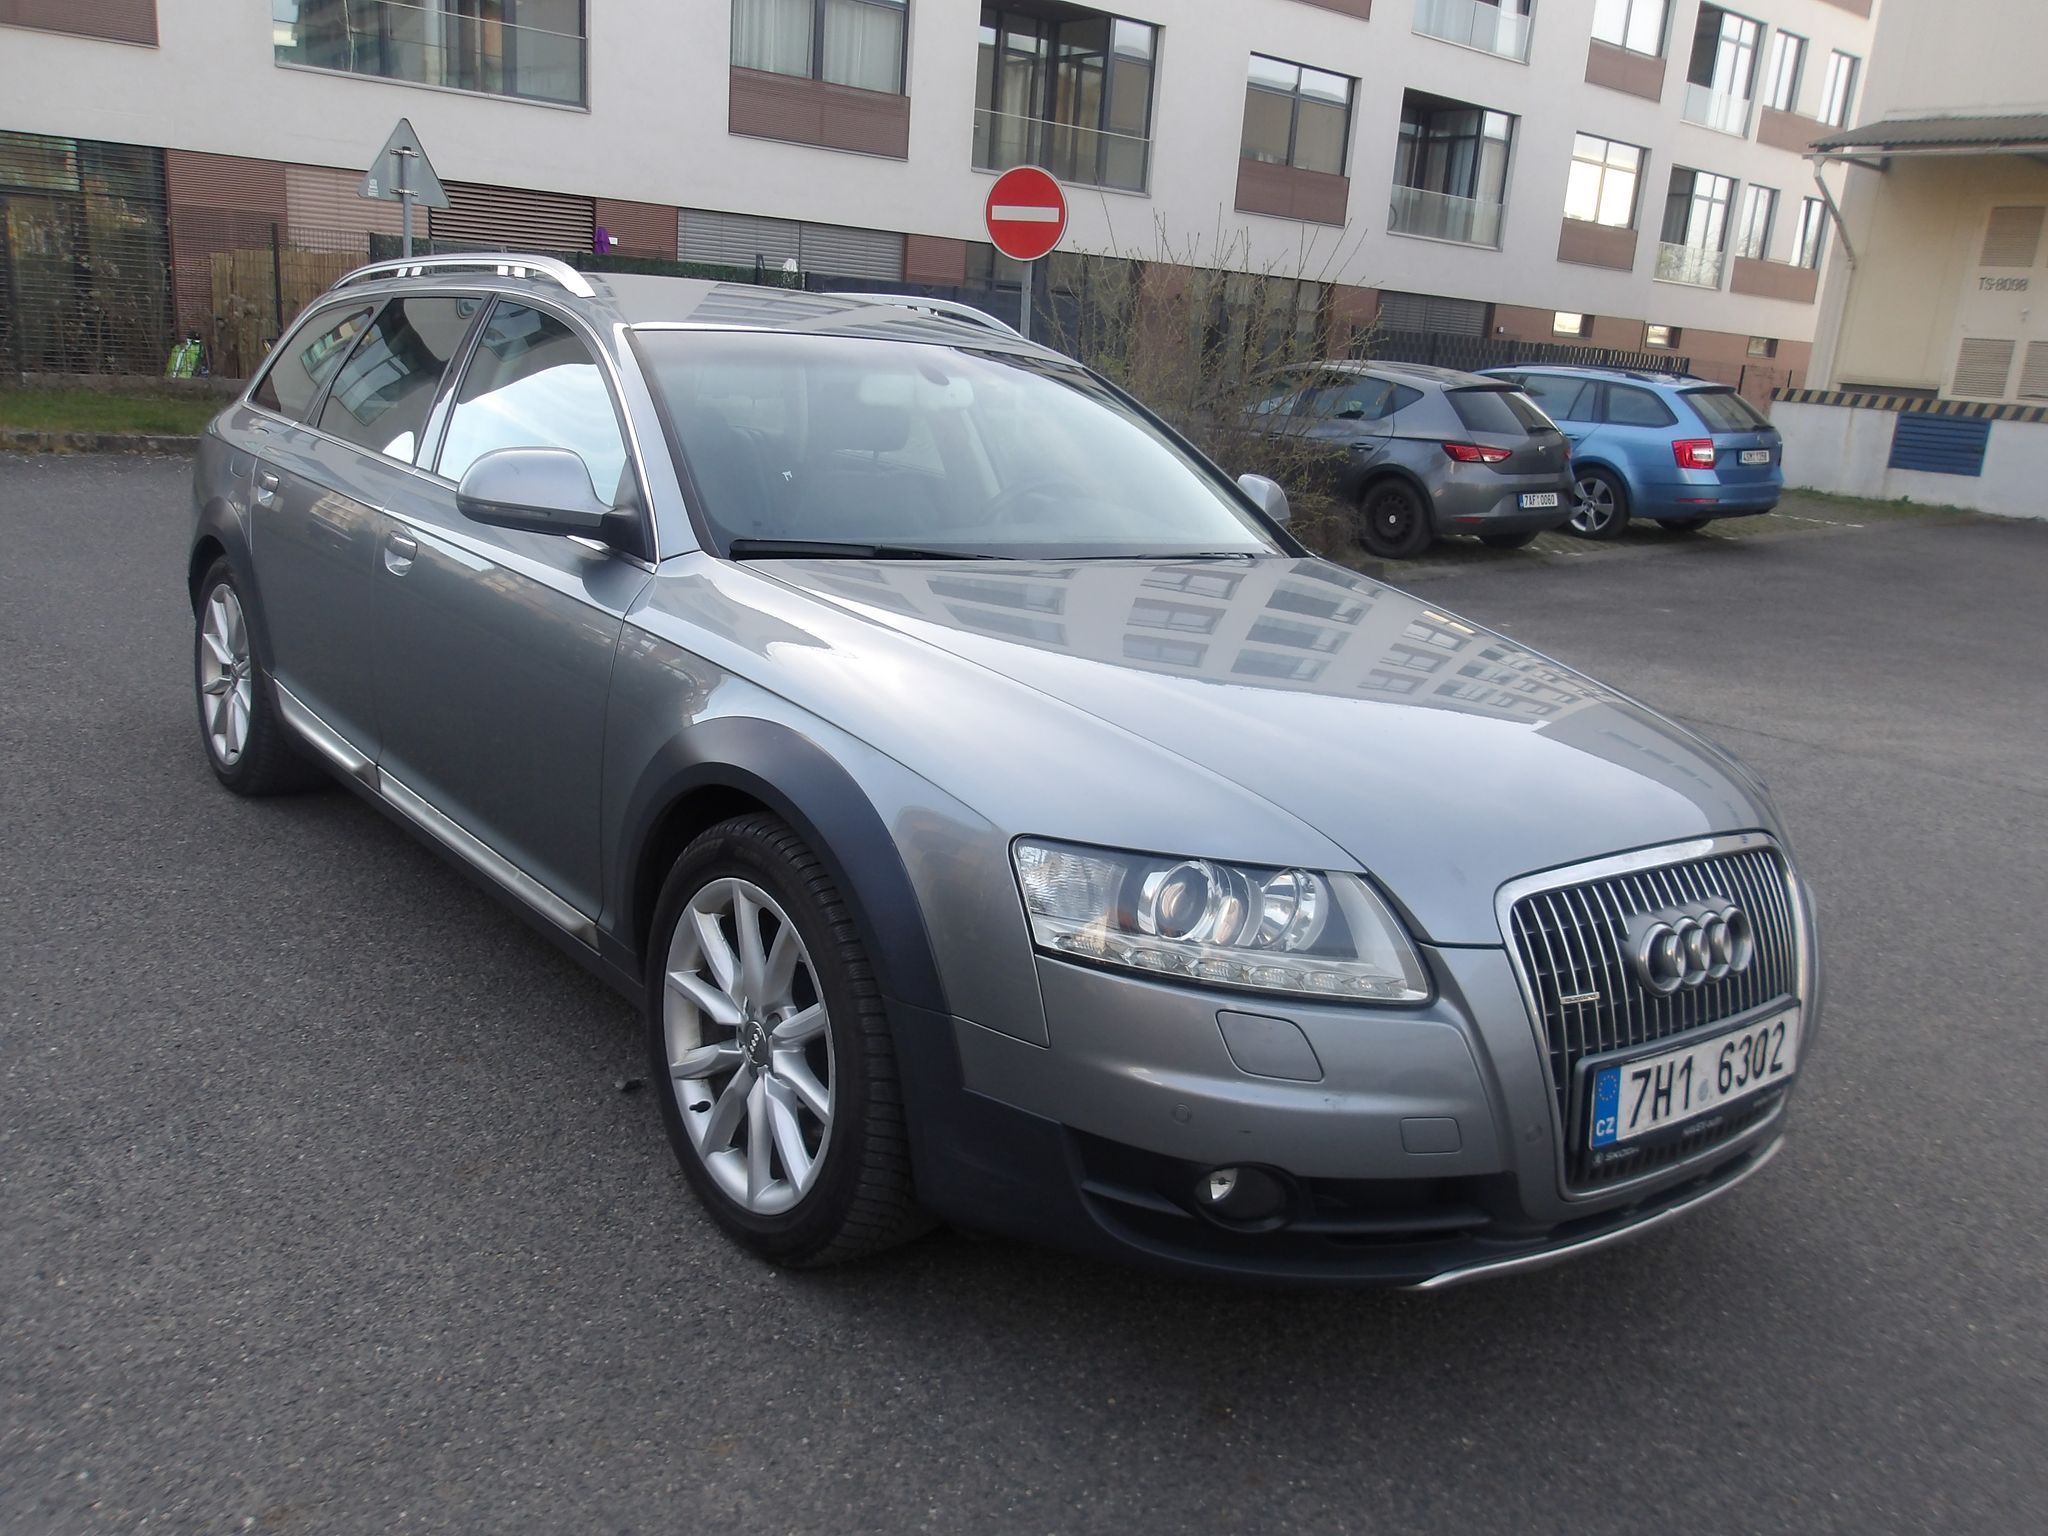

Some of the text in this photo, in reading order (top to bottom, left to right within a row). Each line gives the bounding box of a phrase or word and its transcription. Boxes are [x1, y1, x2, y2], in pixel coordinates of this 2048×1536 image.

[1524, 495, 1536, 506] 7AF
[1629, 1020, 1785, 1129] 7H1 6302
[1595, 1116, 1615, 1137] CZ
